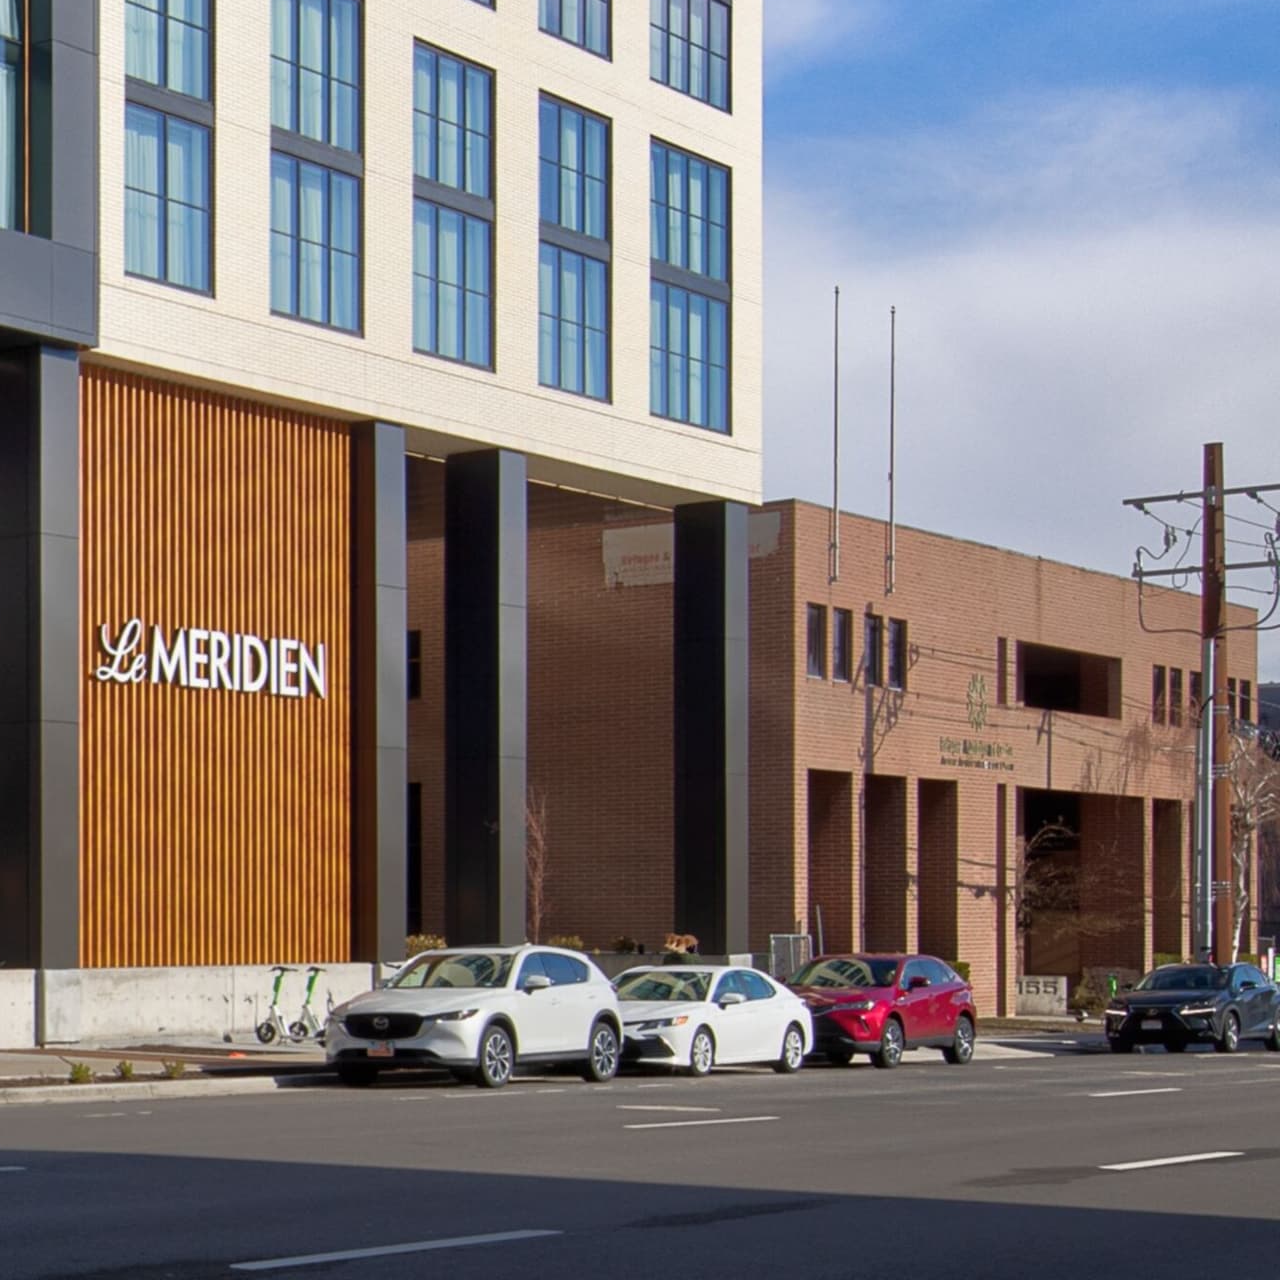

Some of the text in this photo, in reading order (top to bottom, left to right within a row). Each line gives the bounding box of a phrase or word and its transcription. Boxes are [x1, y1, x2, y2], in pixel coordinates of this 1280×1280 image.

[96, 618, 325, 700] Le MERIDIEN
[1016, 980, 1058, 995] 155
